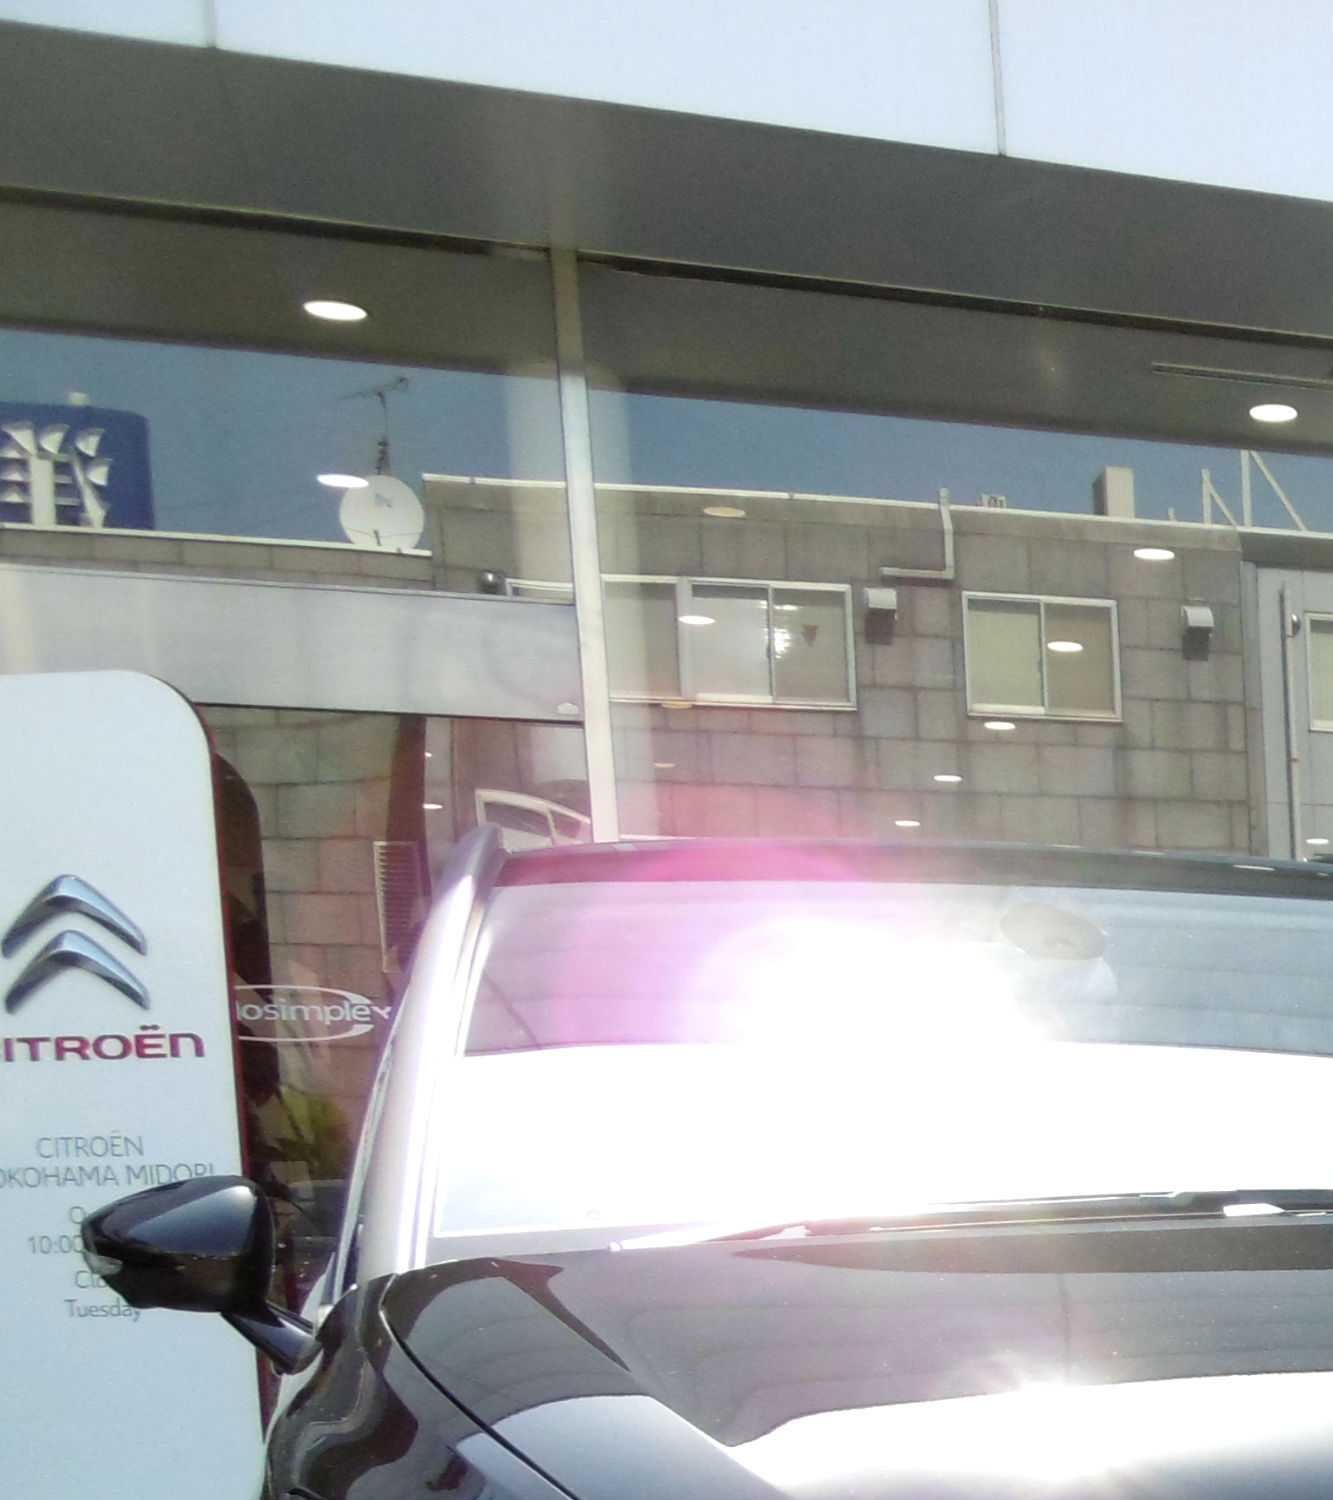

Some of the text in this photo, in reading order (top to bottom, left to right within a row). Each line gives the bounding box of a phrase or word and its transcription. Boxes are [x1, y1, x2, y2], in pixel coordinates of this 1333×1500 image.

[236, 998, 393, 1025] osimplex
[0, 1024, 206, 1062] ITROËN
[36, 1130, 144, 1158] CITROËN
[0, 1165, 119, 1188] KOHAMA
[64, 1297, 142, 1322] Tuesday
